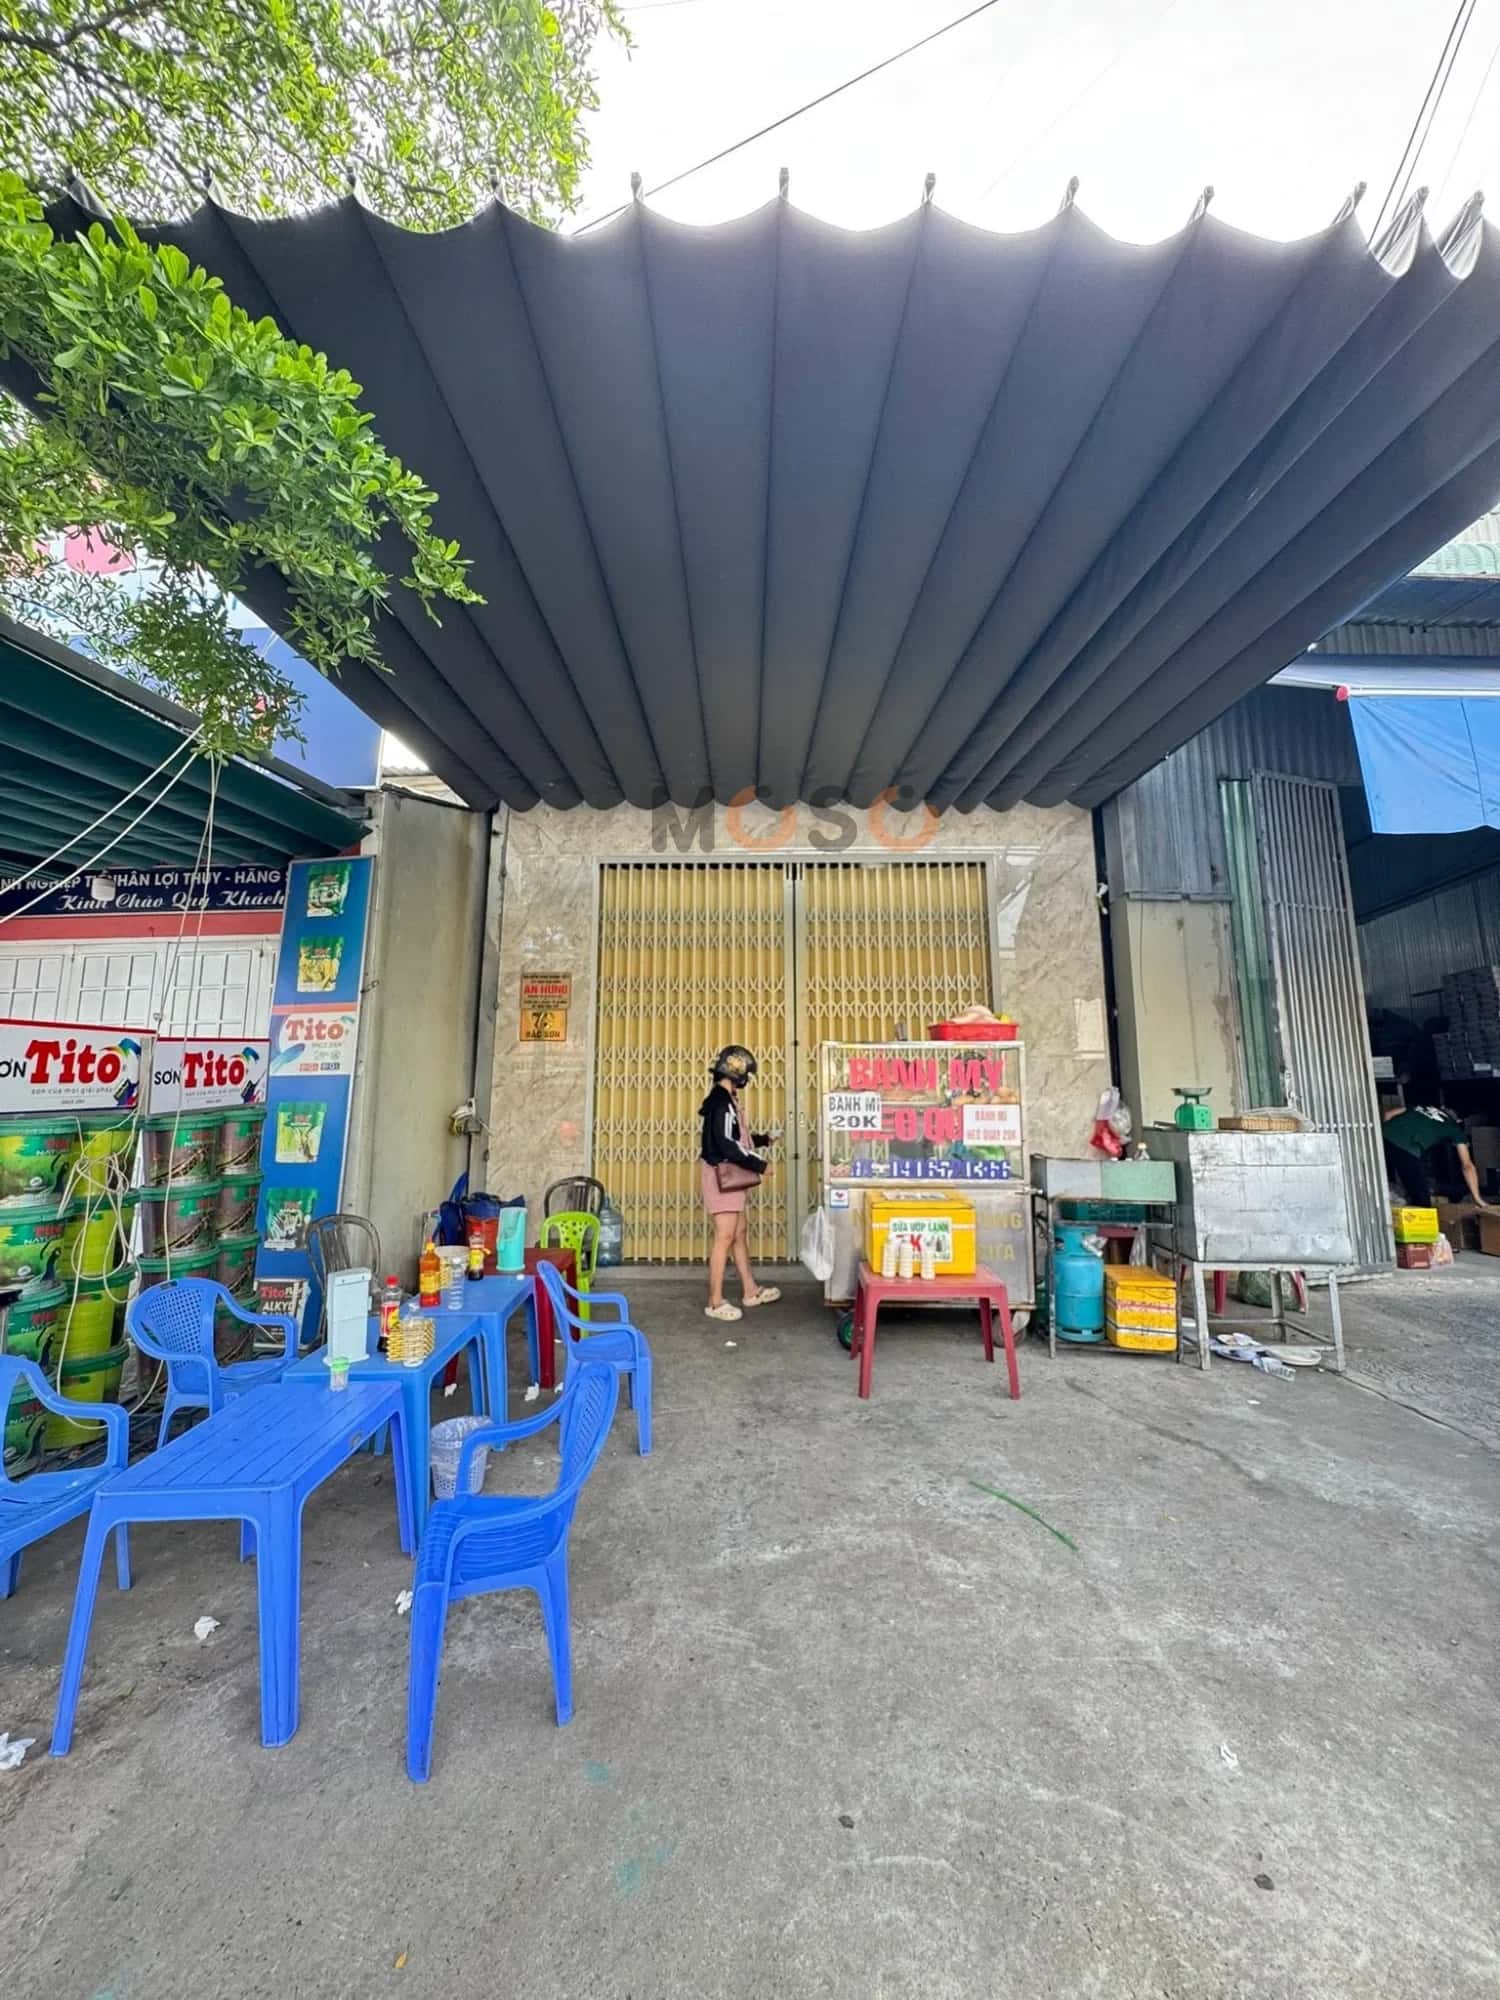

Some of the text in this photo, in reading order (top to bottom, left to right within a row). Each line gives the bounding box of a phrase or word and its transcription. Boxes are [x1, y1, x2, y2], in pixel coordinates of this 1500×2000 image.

[155, 872, 178, 889] LỢI
[286, 1018, 344, 1041] Tito
[25, 1038, 121, 1084] Tito
[184, 1049, 245, 1088] Tito
[830, 1115, 877, 1128] 20K
